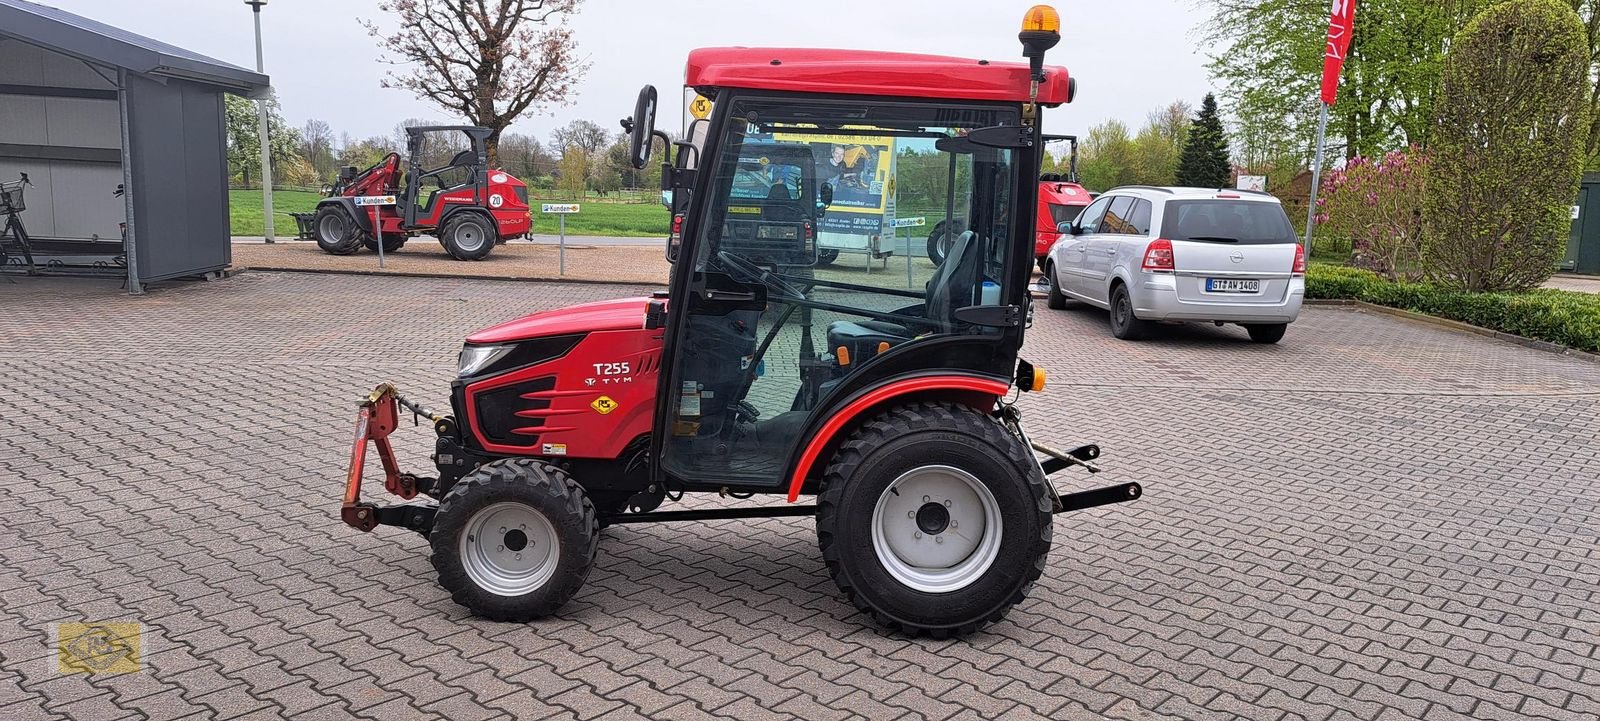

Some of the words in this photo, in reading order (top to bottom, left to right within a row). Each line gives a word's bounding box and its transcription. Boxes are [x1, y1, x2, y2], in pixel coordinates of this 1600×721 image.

[492, 196, 501, 206] 20
[896, 218, 916, 226] Kunden
[1213, 280, 1222, 289] GT
[1228, 281, 1238, 289] AW
[1239, 281, 1258, 290] 1408
[592, 361, 630, 375] T255
